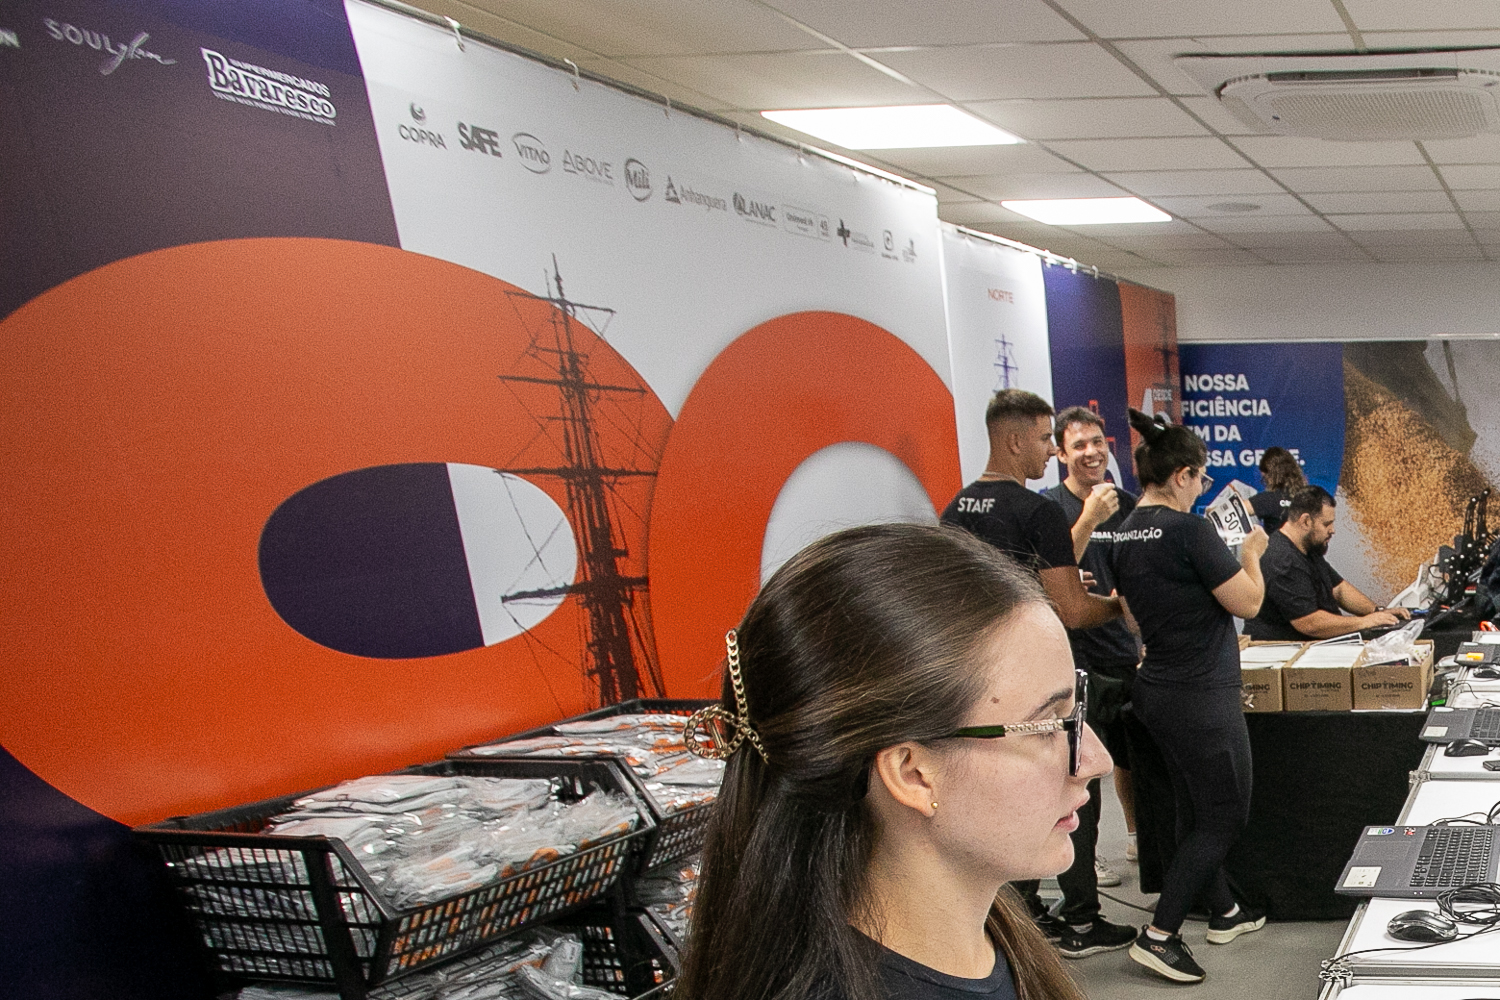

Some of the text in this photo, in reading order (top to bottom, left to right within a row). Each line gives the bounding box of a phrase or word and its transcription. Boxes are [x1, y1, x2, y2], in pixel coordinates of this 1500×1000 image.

[205, 50, 336, 117] Bavaresco
[229, 58, 331, 98] SUPERMERCADOS
[399, 123, 447, 150] COPRA
[457, 121, 502, 158] SAFE
[563, 149, 613, 180] ABOVE
[743, 198, 776, 223] LANAC
[987, 288, 1015, 304] NORTE
[1185, 374, 1249, 392] NOSSA
[1181, 396, 1272, 417] FICIÊNCIA
[1214, 425, 1242, 442] DA
[1205, 449, 1236, 467] SSA
[957, 497, 995, 514] STAFF
[1113, 526, 1163, 544] ORGANIZAÇÃO
[1361, 681, 1413, 690] CHIPTIMING
